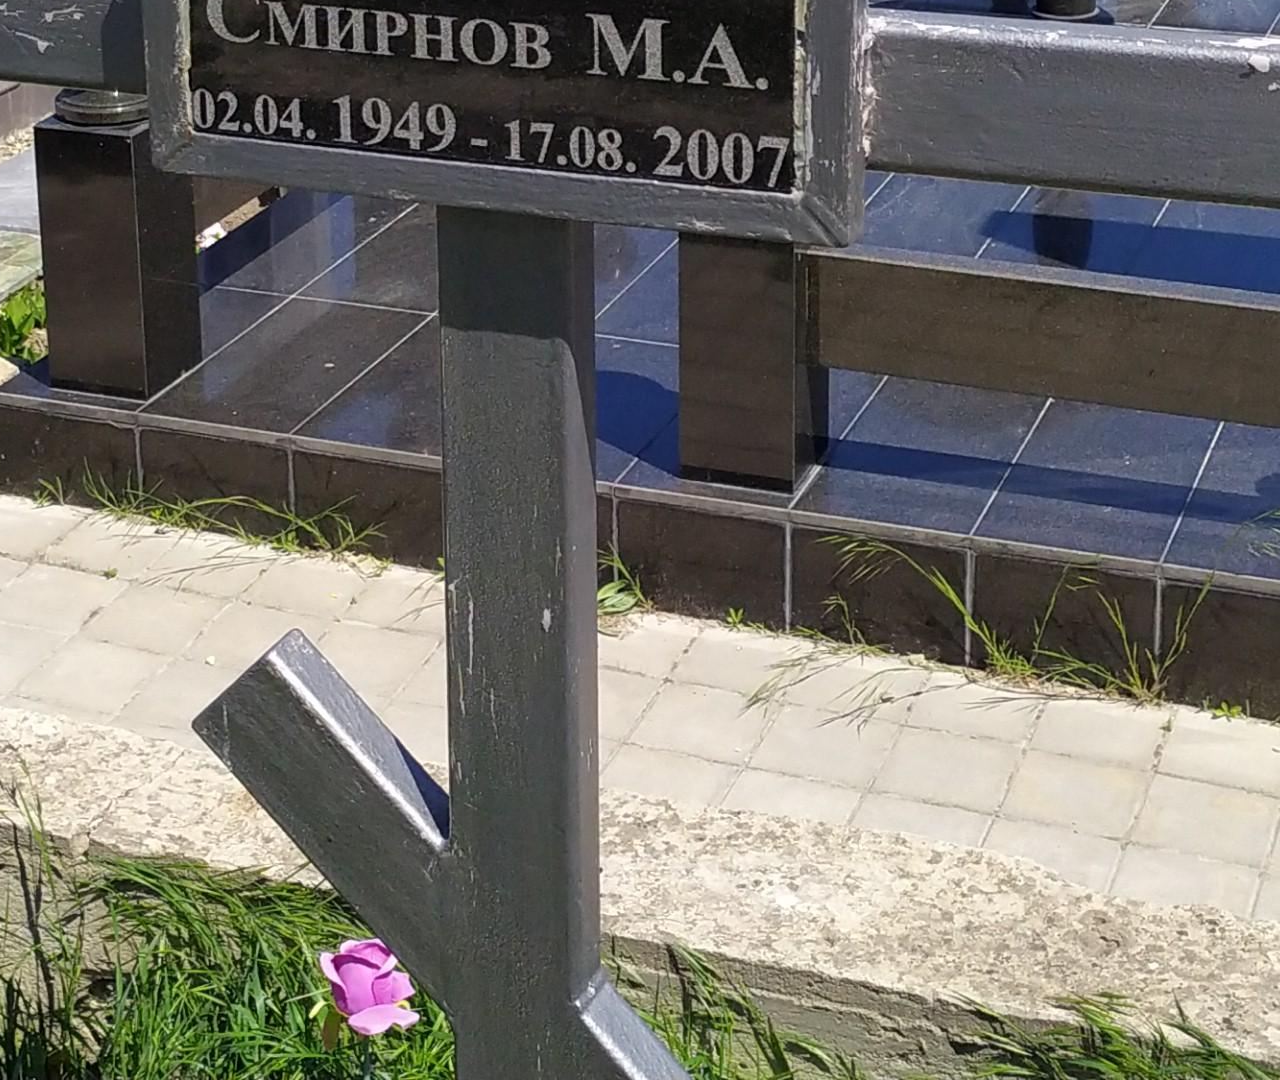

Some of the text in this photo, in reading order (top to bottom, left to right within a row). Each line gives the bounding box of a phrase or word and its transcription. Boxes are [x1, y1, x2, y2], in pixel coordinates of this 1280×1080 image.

[586, 12, 770, 91] М.А.
[192, 87, 317, 141] 02.04.
[333, 94, 456, 153] 1949
[503, 120, 637, 172] 17.08.
[652, 124, 792, 188] 2007
